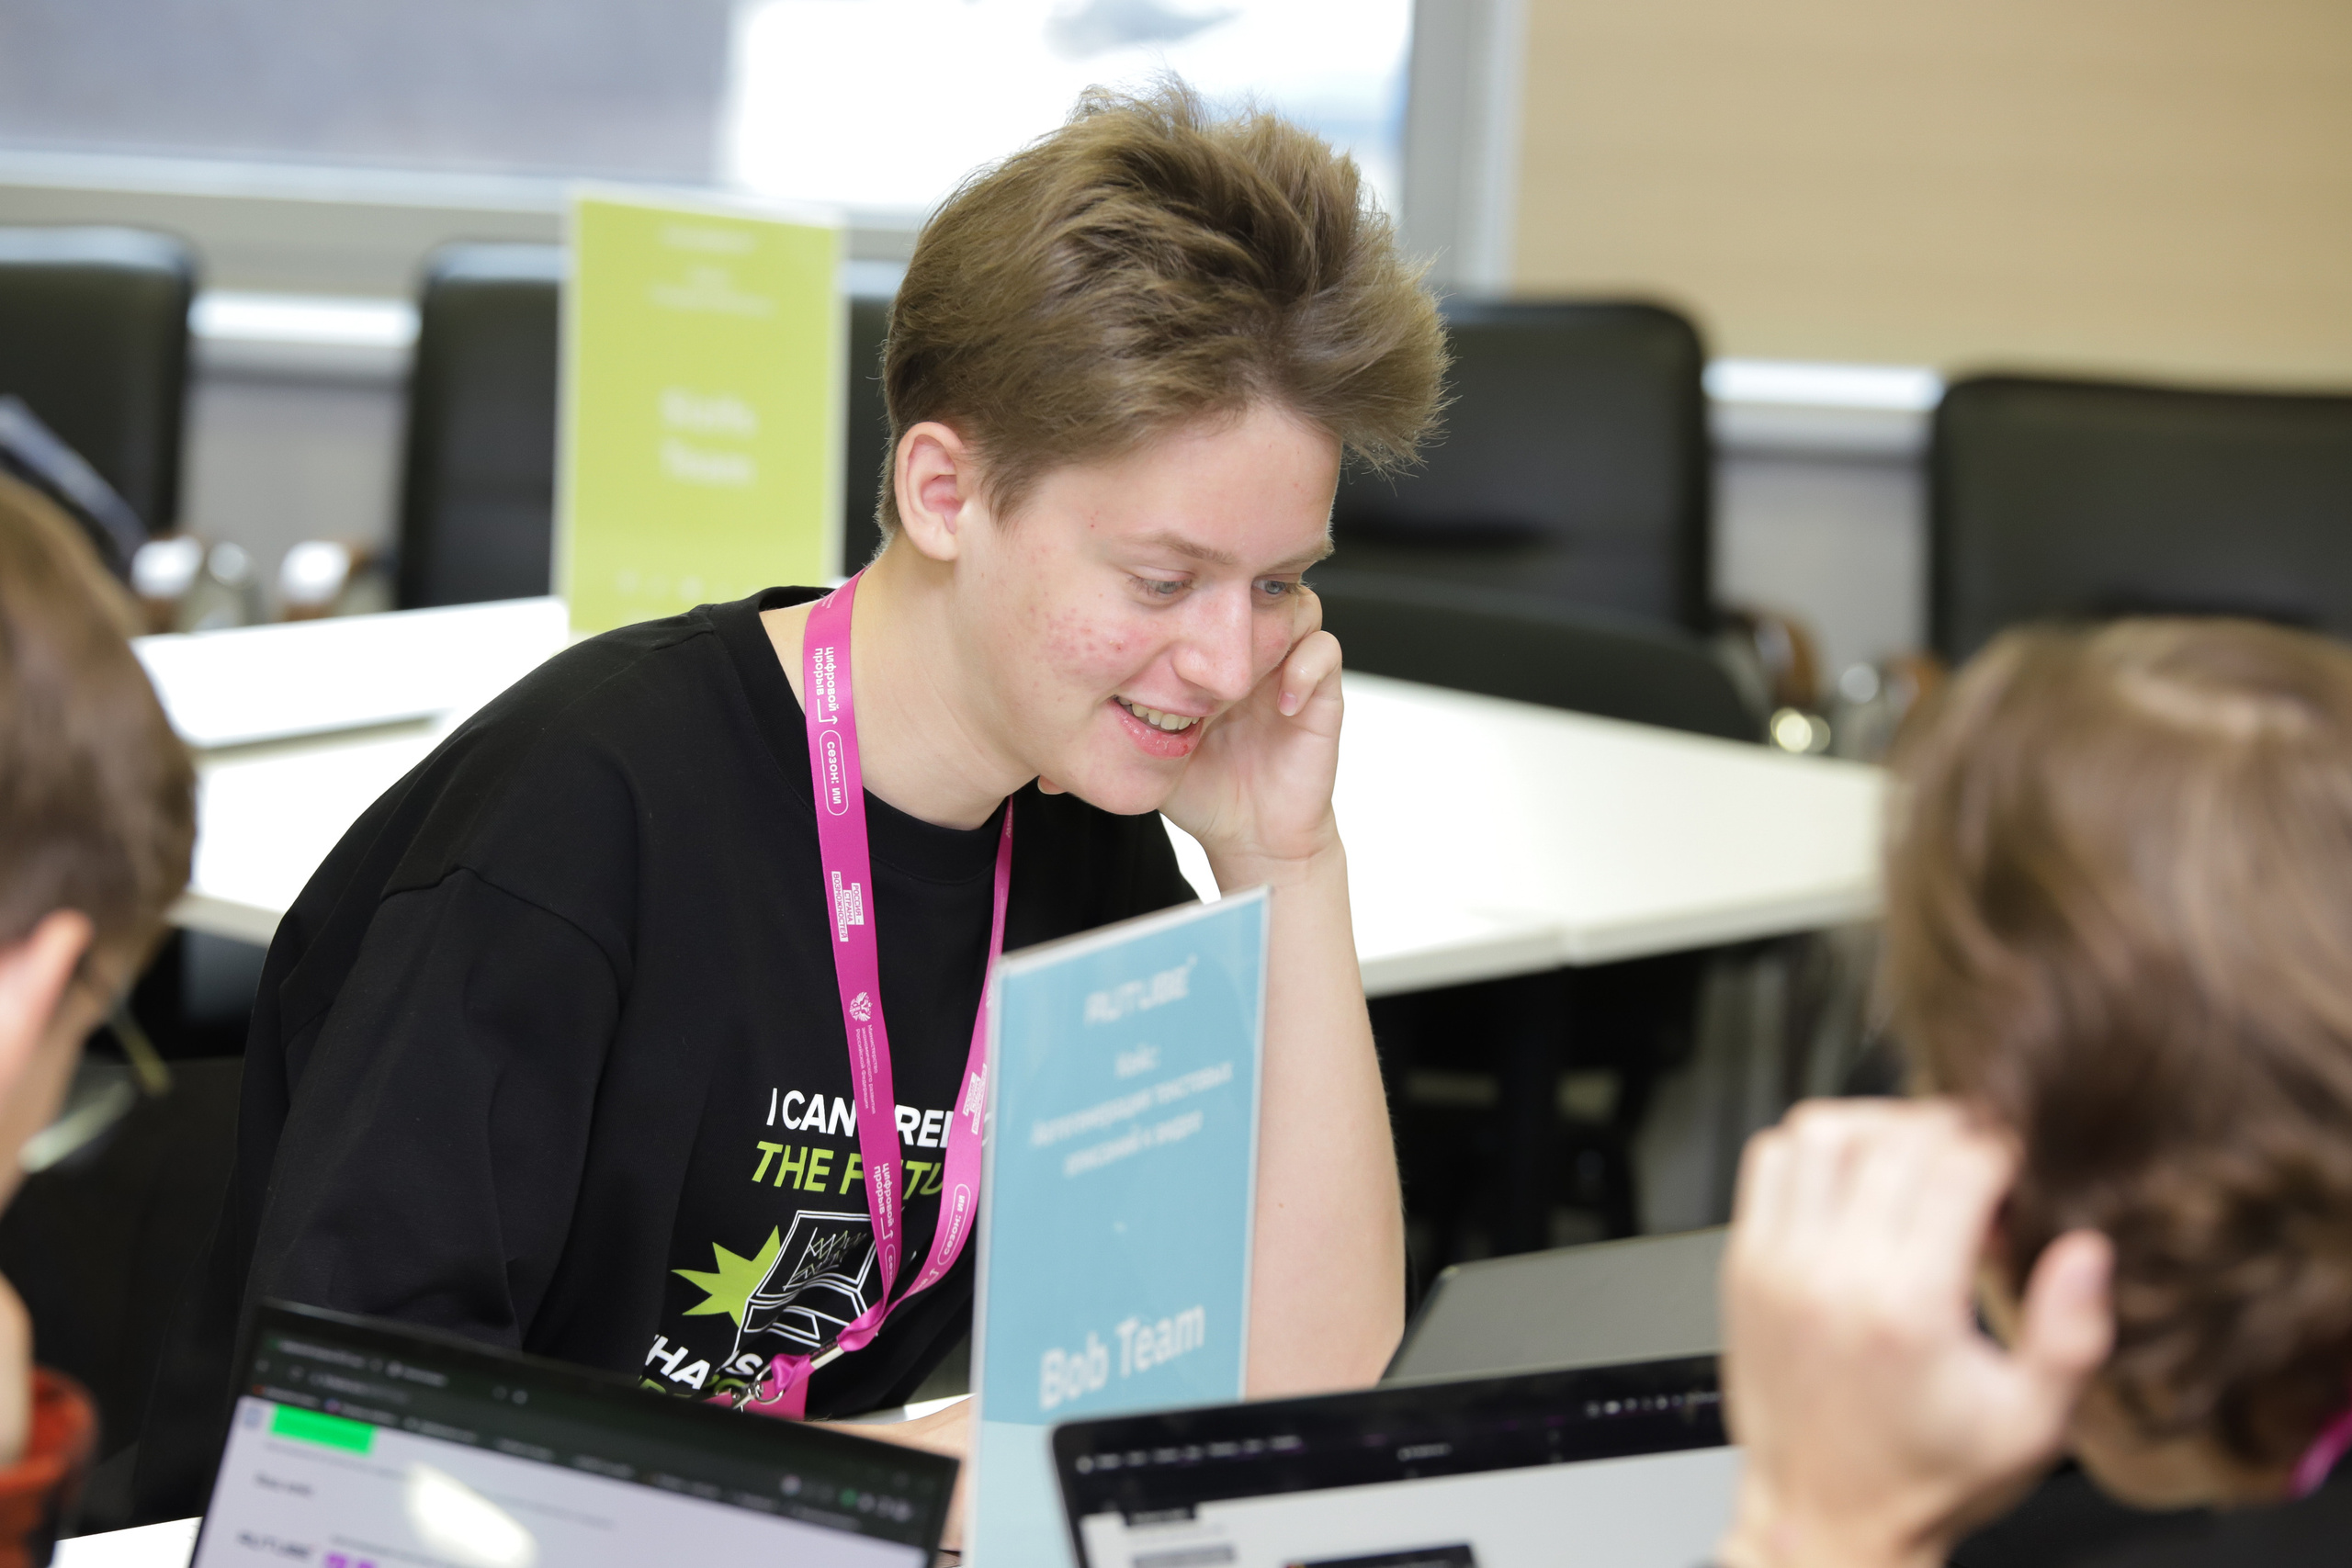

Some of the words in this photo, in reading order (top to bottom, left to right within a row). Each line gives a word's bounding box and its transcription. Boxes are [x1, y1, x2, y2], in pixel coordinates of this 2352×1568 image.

[813, 648, 825, 695] прорыв
[824, 647, 840, 712] цифровой
[827, 741, 840, 784] сезон:
[833, 874, 848, 939] ВОЗМОЖНОСТЕЙ
[844, 891, 854, 922] СТРАНА
[853, 885, 863, 917] РОССИЯ
[868, 1024, 878, 1074] Министерство
[766, 1088, 777, 1126] I
[782, 1090, 857, 1137] CAN
[752, 1140, 834, 1192] THE
[874, 1166, 886, 1214] прорыв
[882, 1163, 895, 1227] цифровой
[1039, 1330, 1110, 1412] Bob
[1114, 1304, 1206, 1378] Team
